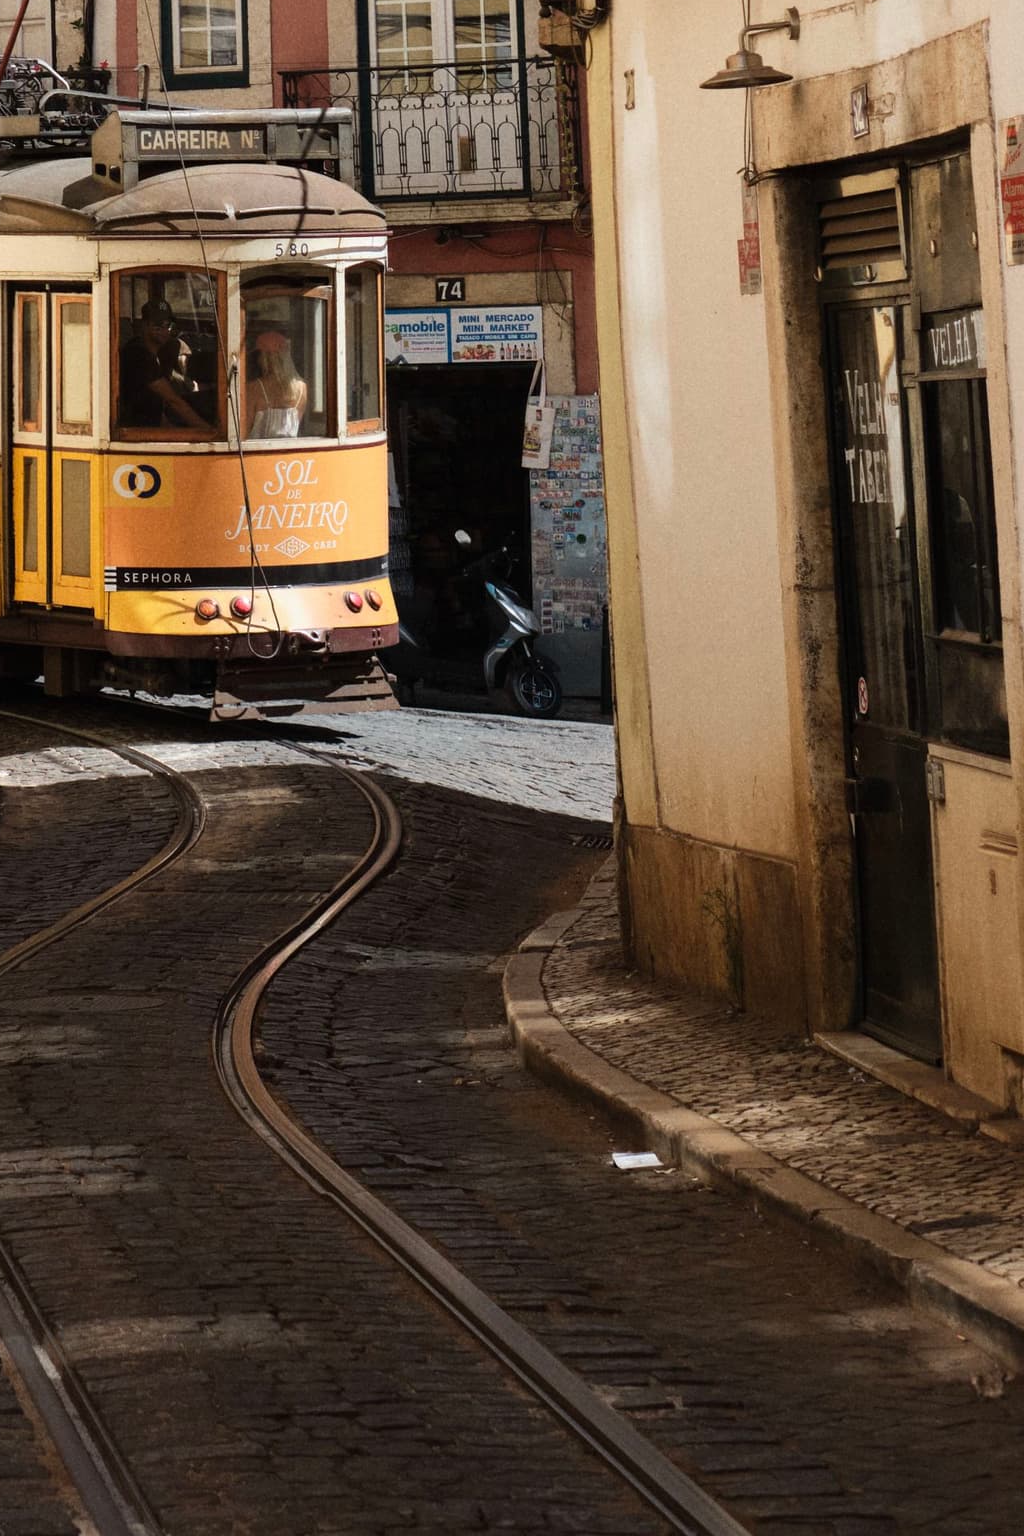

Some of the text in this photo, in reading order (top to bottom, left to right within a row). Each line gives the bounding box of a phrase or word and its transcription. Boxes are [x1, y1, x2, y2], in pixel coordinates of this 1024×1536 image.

[140, 130, 231, 150] CARREIRA
[275, 243, 309, 257] 580
[437, 280, 462, 300] 74
[458, 313, 535, 323] MINI MERCADO
[462, 323, 530, 332] MINI MARKET
[930, 317, 972, 367] VELHA
[263, 459, 318, 495] SOL
[287, 489, 302, 500] DE
[224, 500, 348, 540] JANEIRO
[123, 572, 193, 584] SEPHORA
